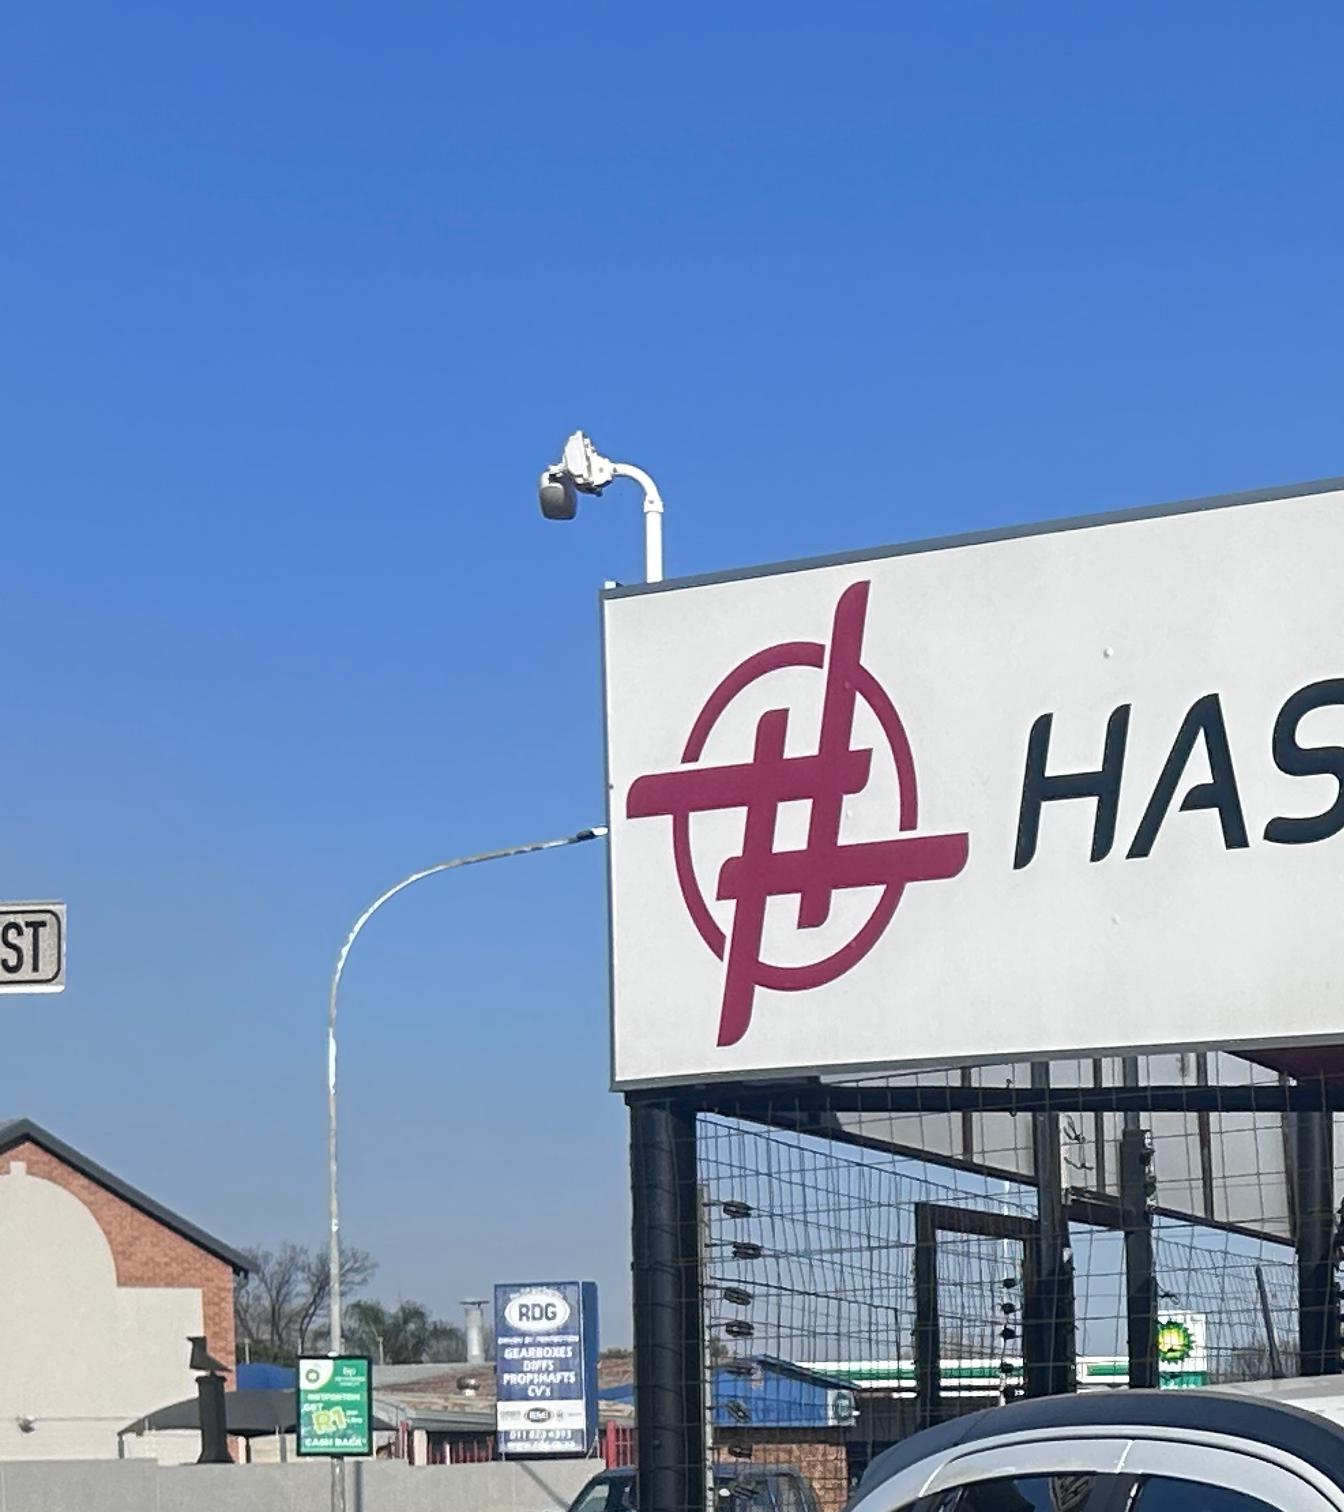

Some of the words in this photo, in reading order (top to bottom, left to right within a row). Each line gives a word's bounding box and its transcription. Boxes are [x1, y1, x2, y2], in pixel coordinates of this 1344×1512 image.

[1, 921, 47, 974] ST
[518, 1303, 557, 1321] RDG
[504, 1347, 572, 1359] GEARBOXES
[503, 1371, 576, 1385] PROPSHAFTS
